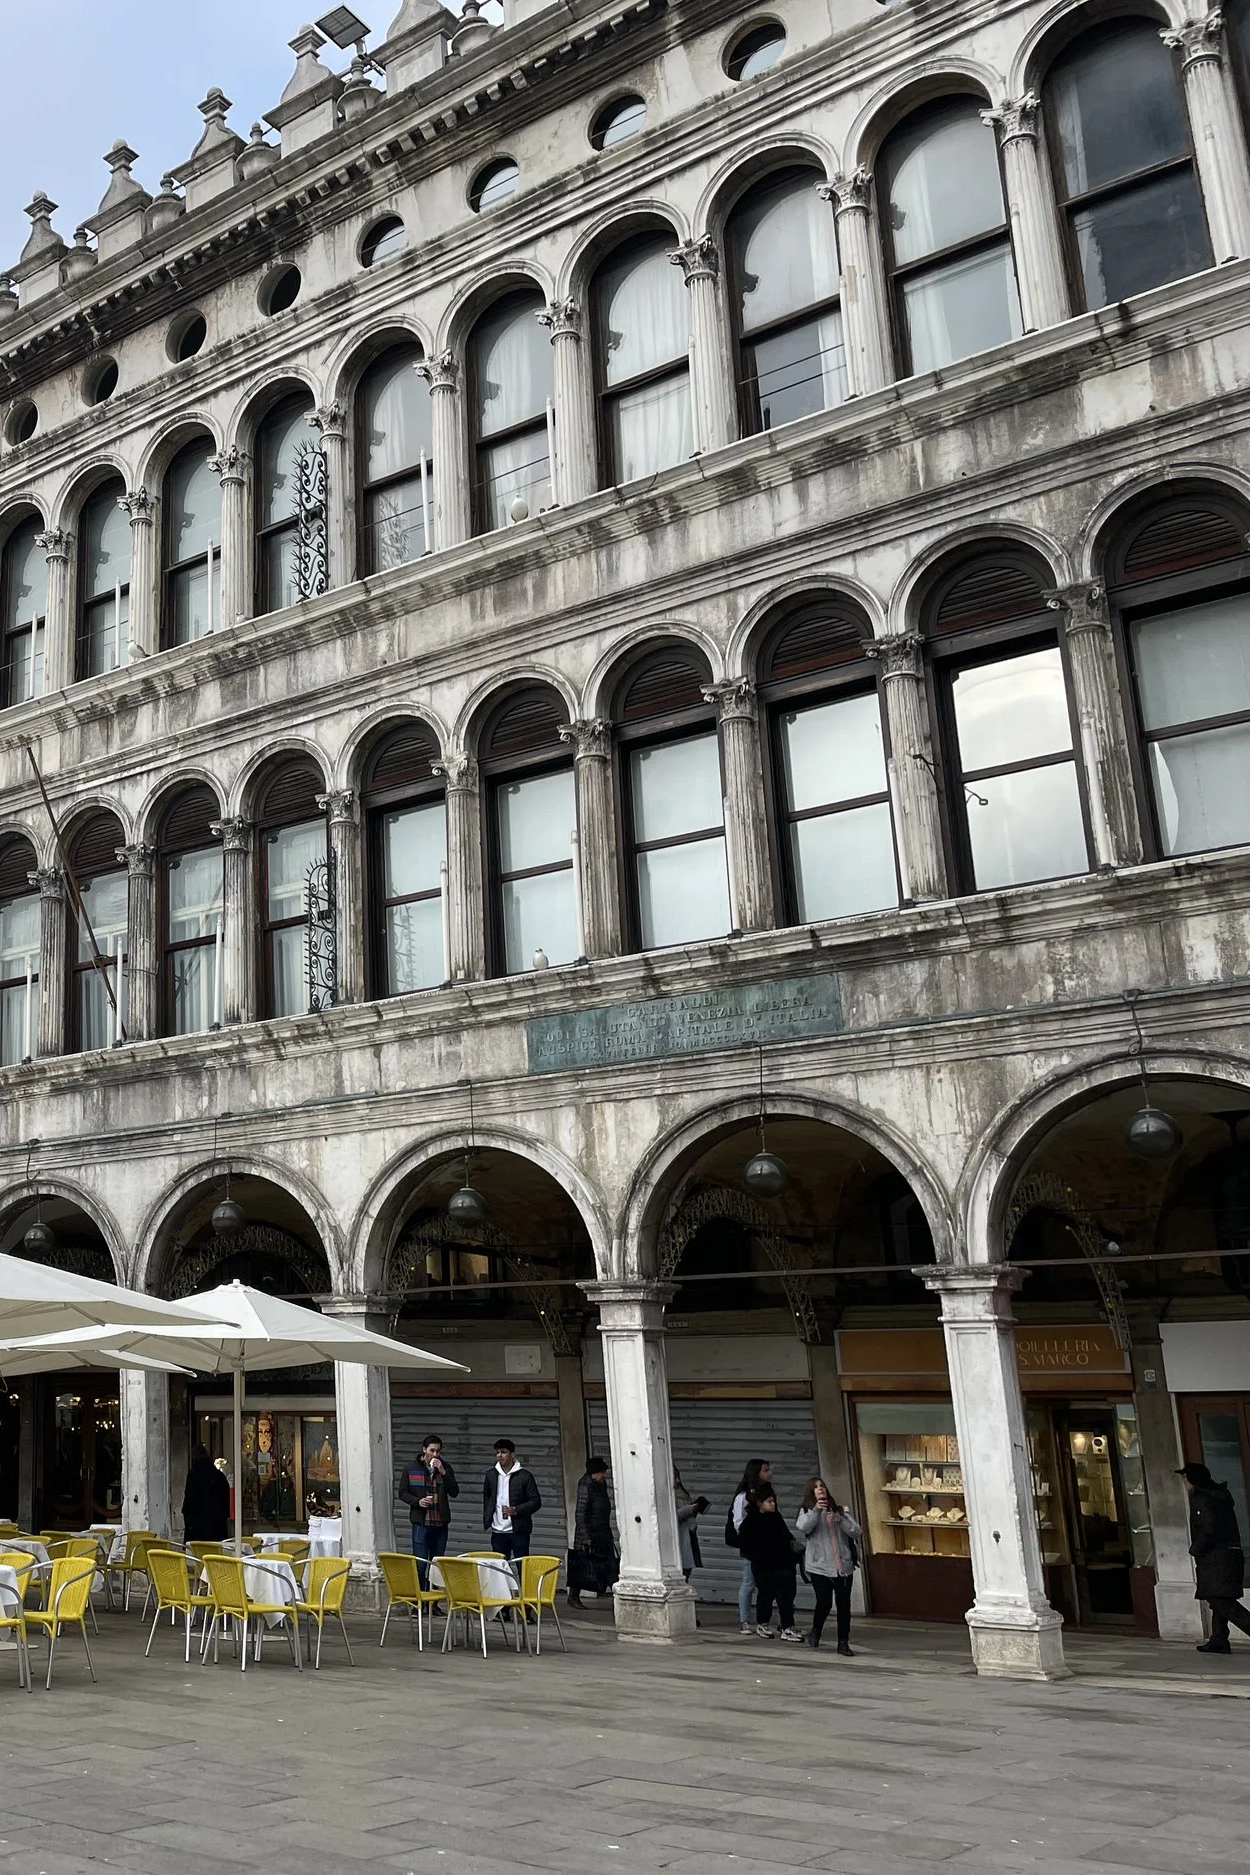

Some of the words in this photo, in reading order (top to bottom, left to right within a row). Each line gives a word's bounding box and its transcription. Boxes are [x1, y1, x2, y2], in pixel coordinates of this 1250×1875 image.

[580, 1016, 667, 1038] SALUTANDO
[676, 1006, 744, 1024] VENEZIA
[753, 996, 813, 1014] LIBERA
[627, 994, 719, 1017] GARIBALDI
[605, 1031, 646, 1048] ROMA
[653, 1019, 733, 1040] CAPITALE
[1016, 1340, 1100, 1352] OIELLERIA
[1018, 1353, 1031, 1366] S.
[1033, 1353, 1089, 1366] MARCO
